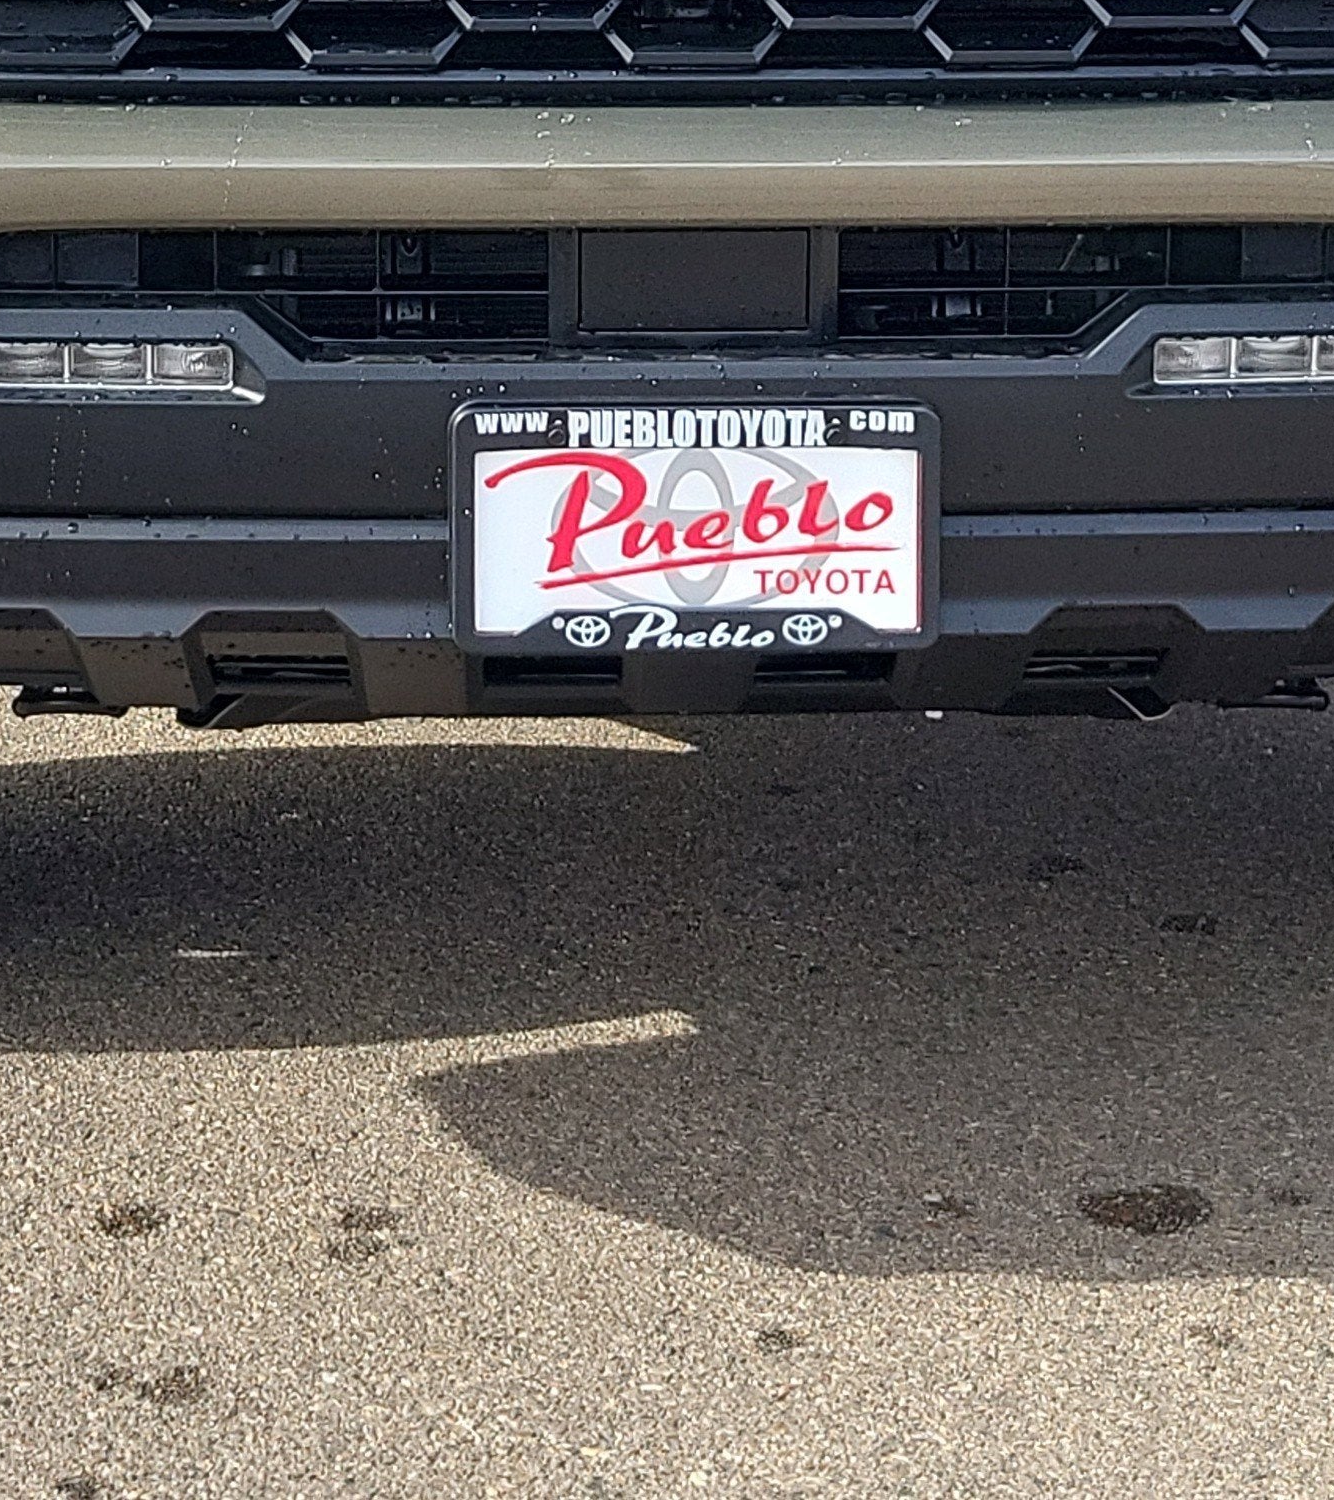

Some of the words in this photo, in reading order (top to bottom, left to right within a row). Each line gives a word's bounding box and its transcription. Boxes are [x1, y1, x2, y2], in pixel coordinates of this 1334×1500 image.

[484, 451, 895, 574] Pueblo
[753, 568, 896, 595] TOYOTA
[609, 604, 776, 650] Pueblo
